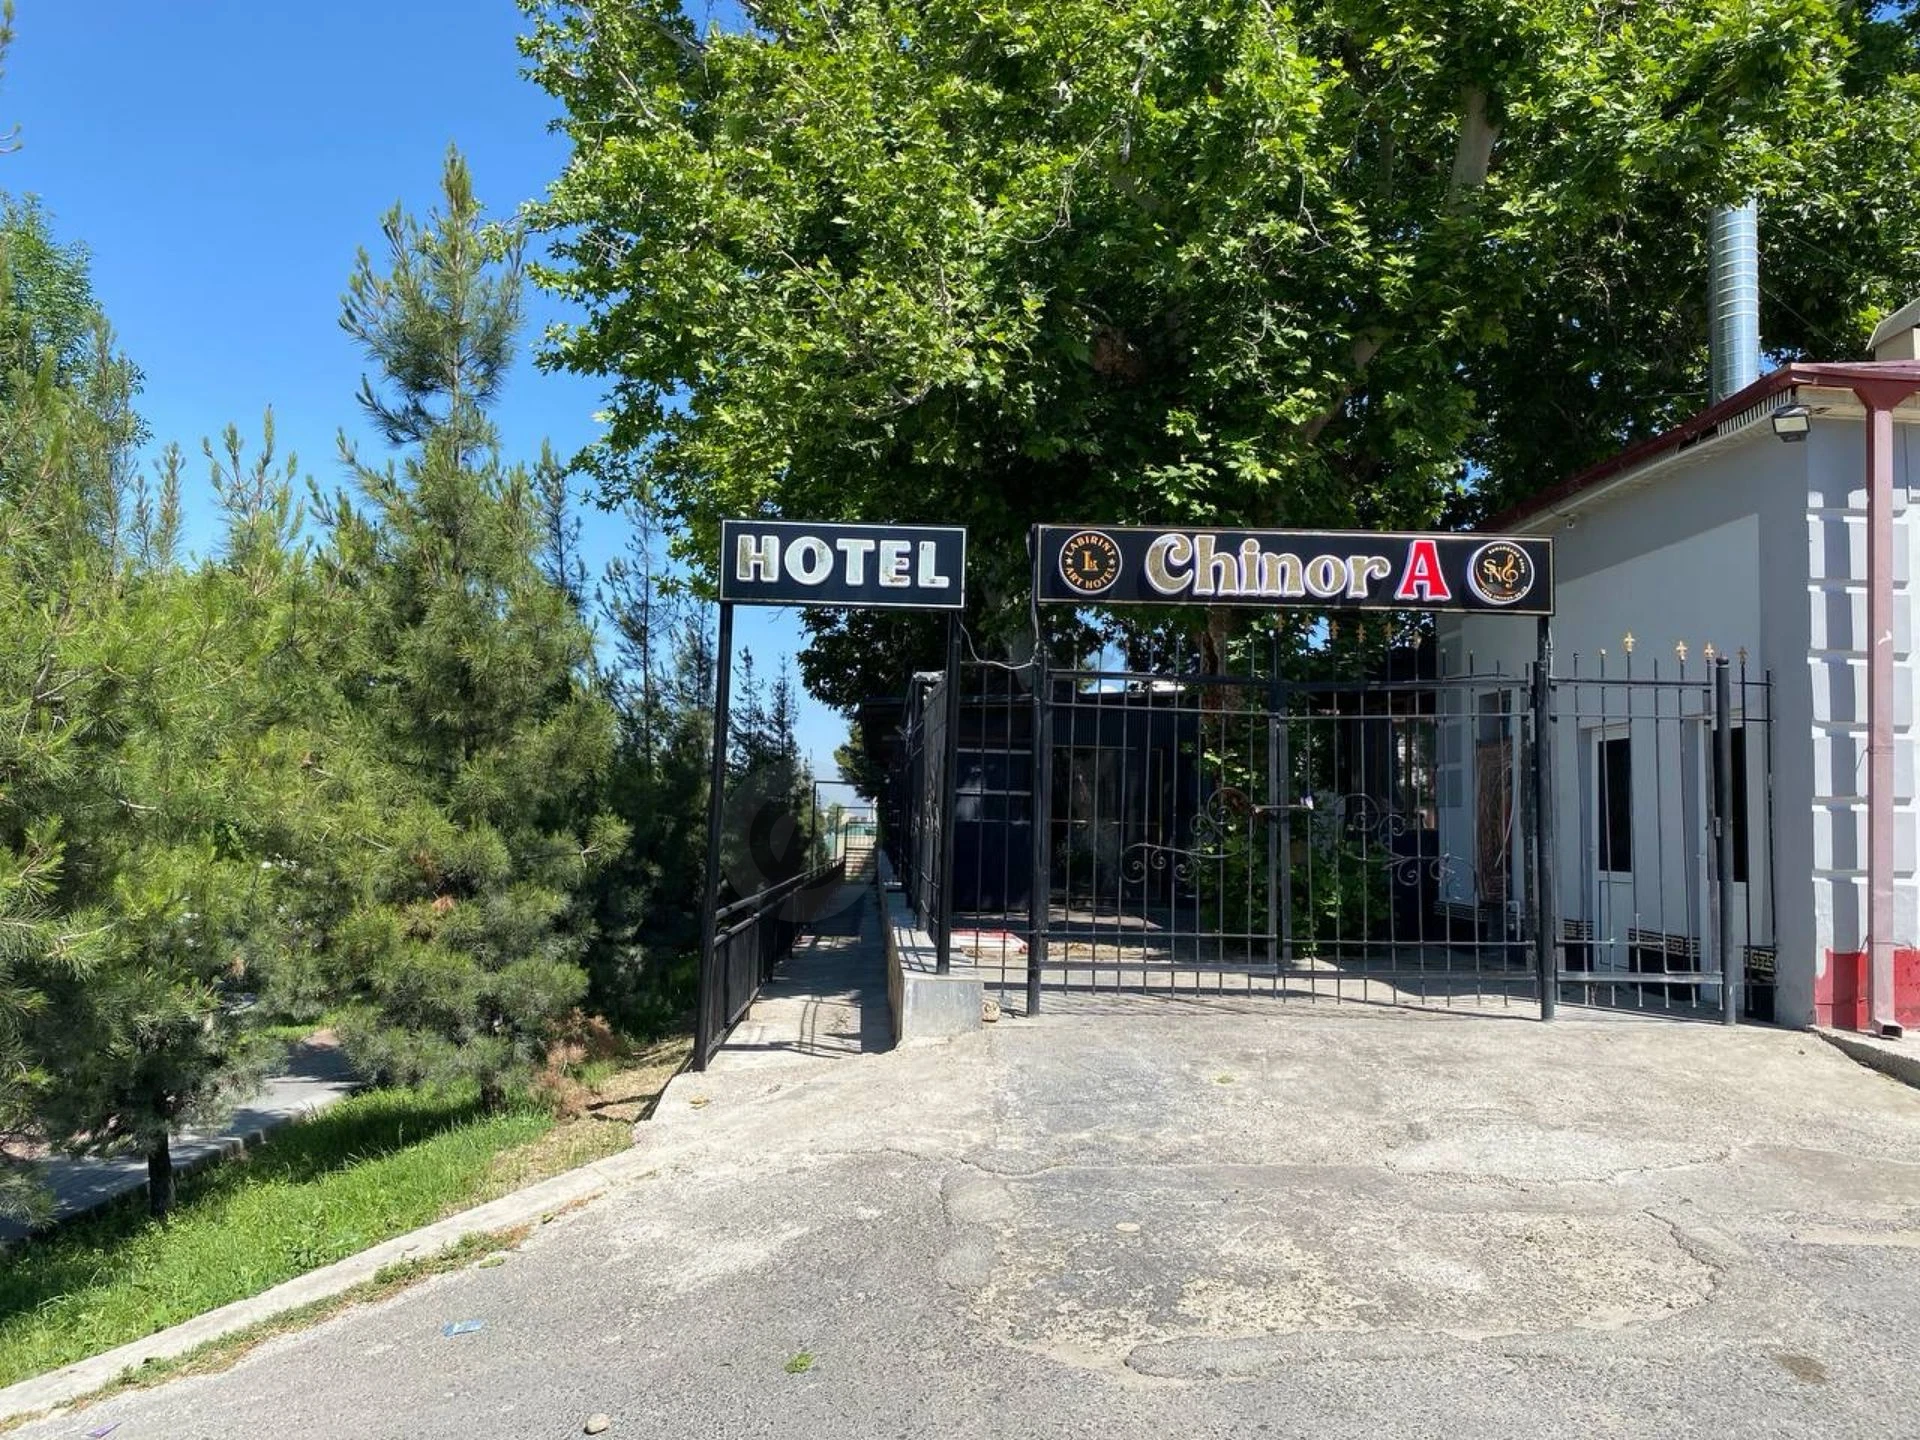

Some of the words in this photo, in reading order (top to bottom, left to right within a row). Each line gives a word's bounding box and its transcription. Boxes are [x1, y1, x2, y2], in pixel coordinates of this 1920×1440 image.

[737, 534, 949, 589] HOTEL
[1065, 535, 1116, 556] LABIRINT
[1065, 567, 1084, 586] ART
[1085, 567, 1116, 589] HOTEL
[1145, 533, 1392, 599] Chinor
[1394, 539, 1452, 602] A
